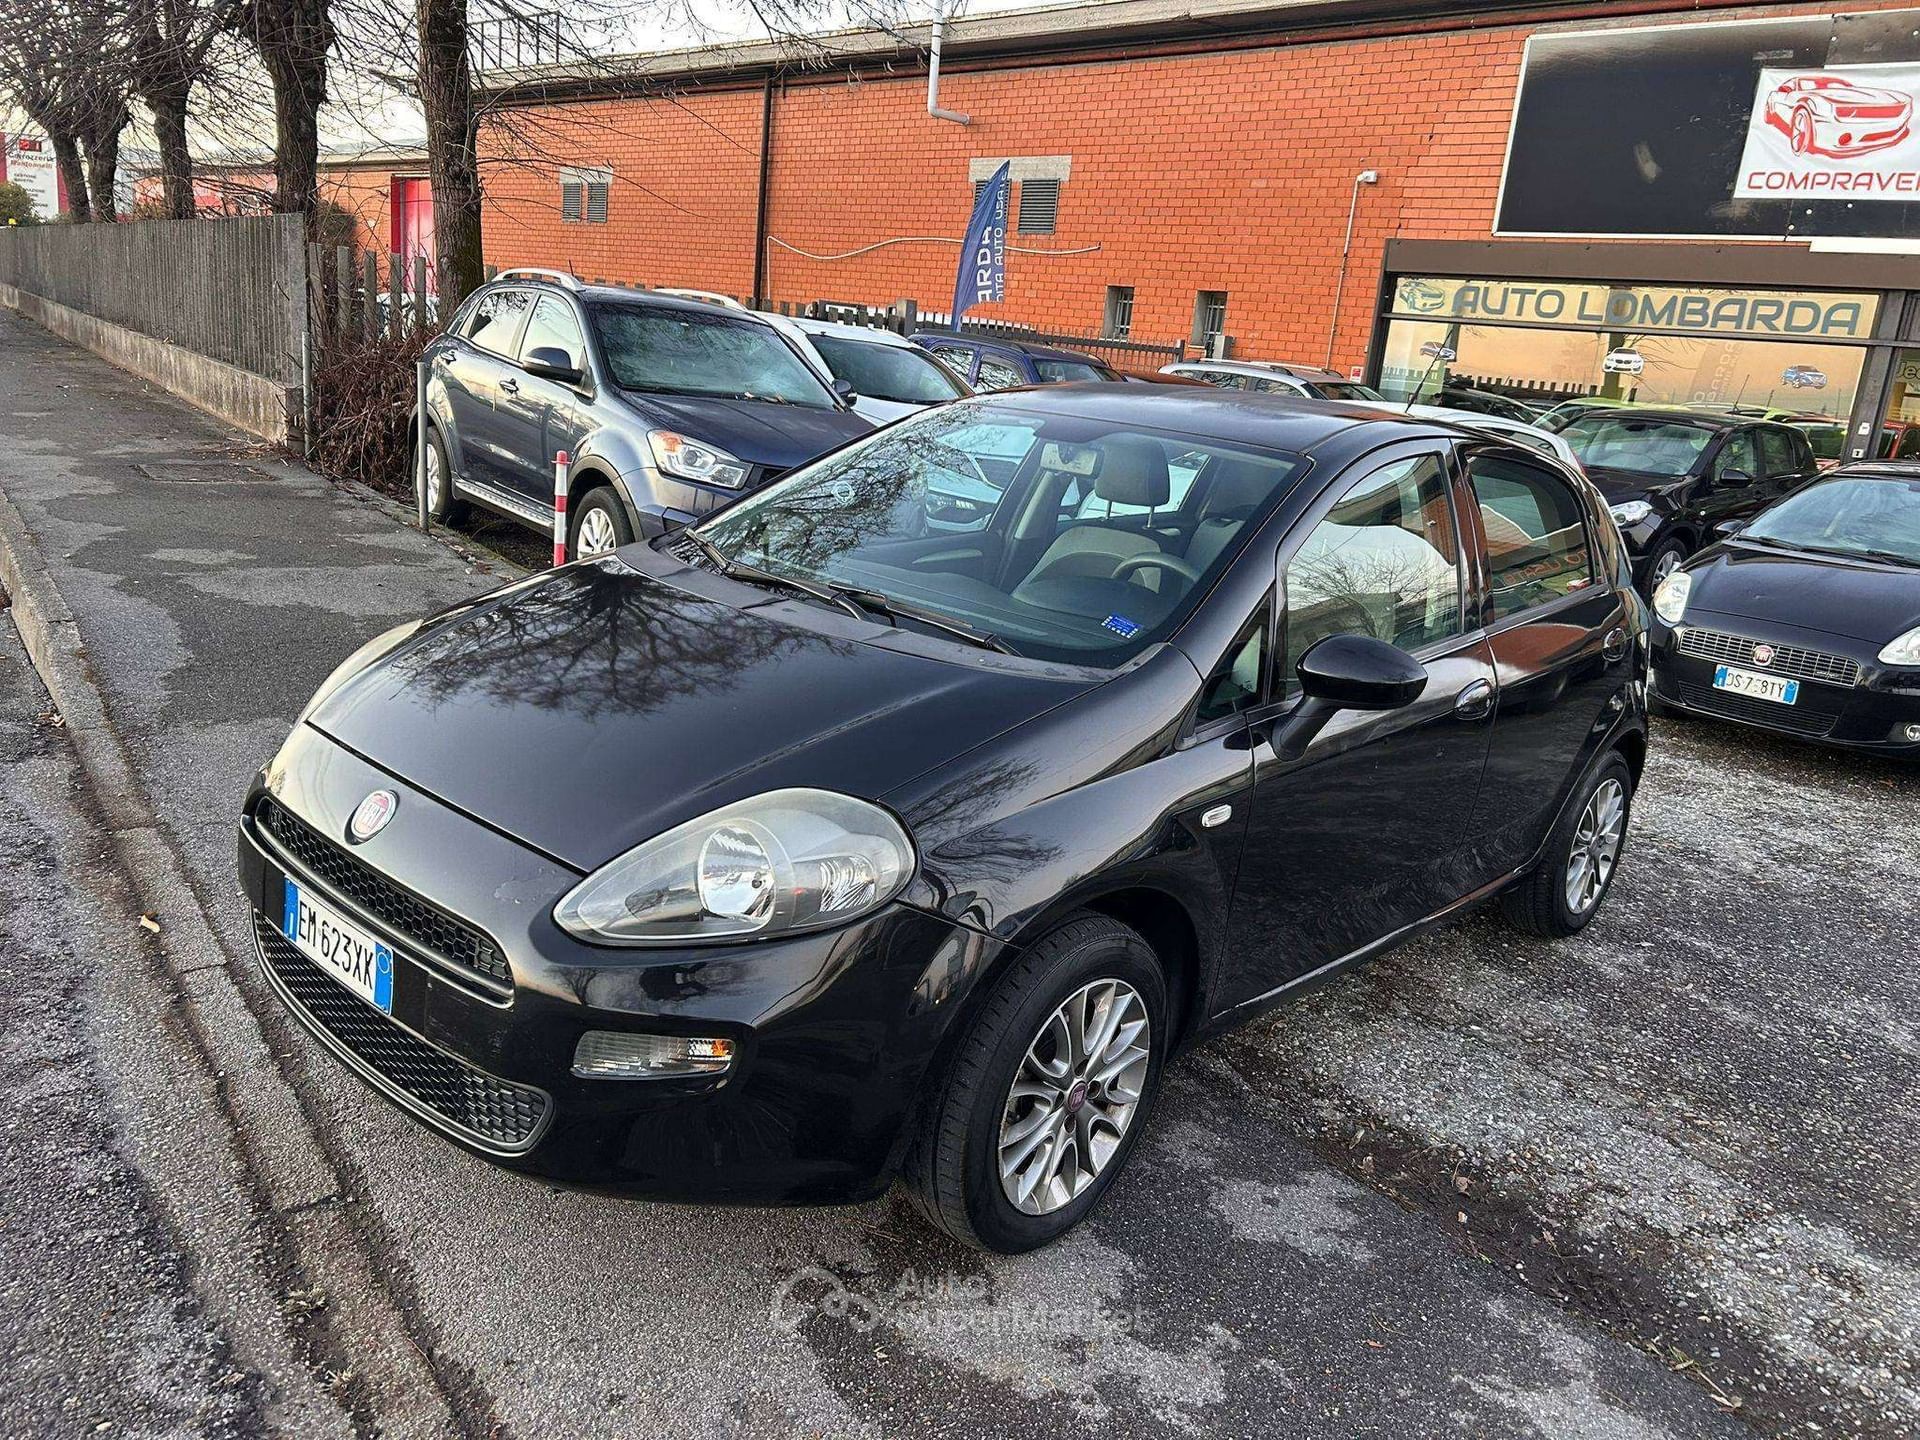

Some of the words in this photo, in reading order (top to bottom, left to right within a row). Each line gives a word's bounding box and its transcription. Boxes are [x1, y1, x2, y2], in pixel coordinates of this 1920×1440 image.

[1747, 171, 1920, 192] COMPRAVE
[994, 227, 1004, 266] AUTO
[1451, 285, 1566, 319] AUTO
[1577, 289, 1862, 336] LOMBARDA
